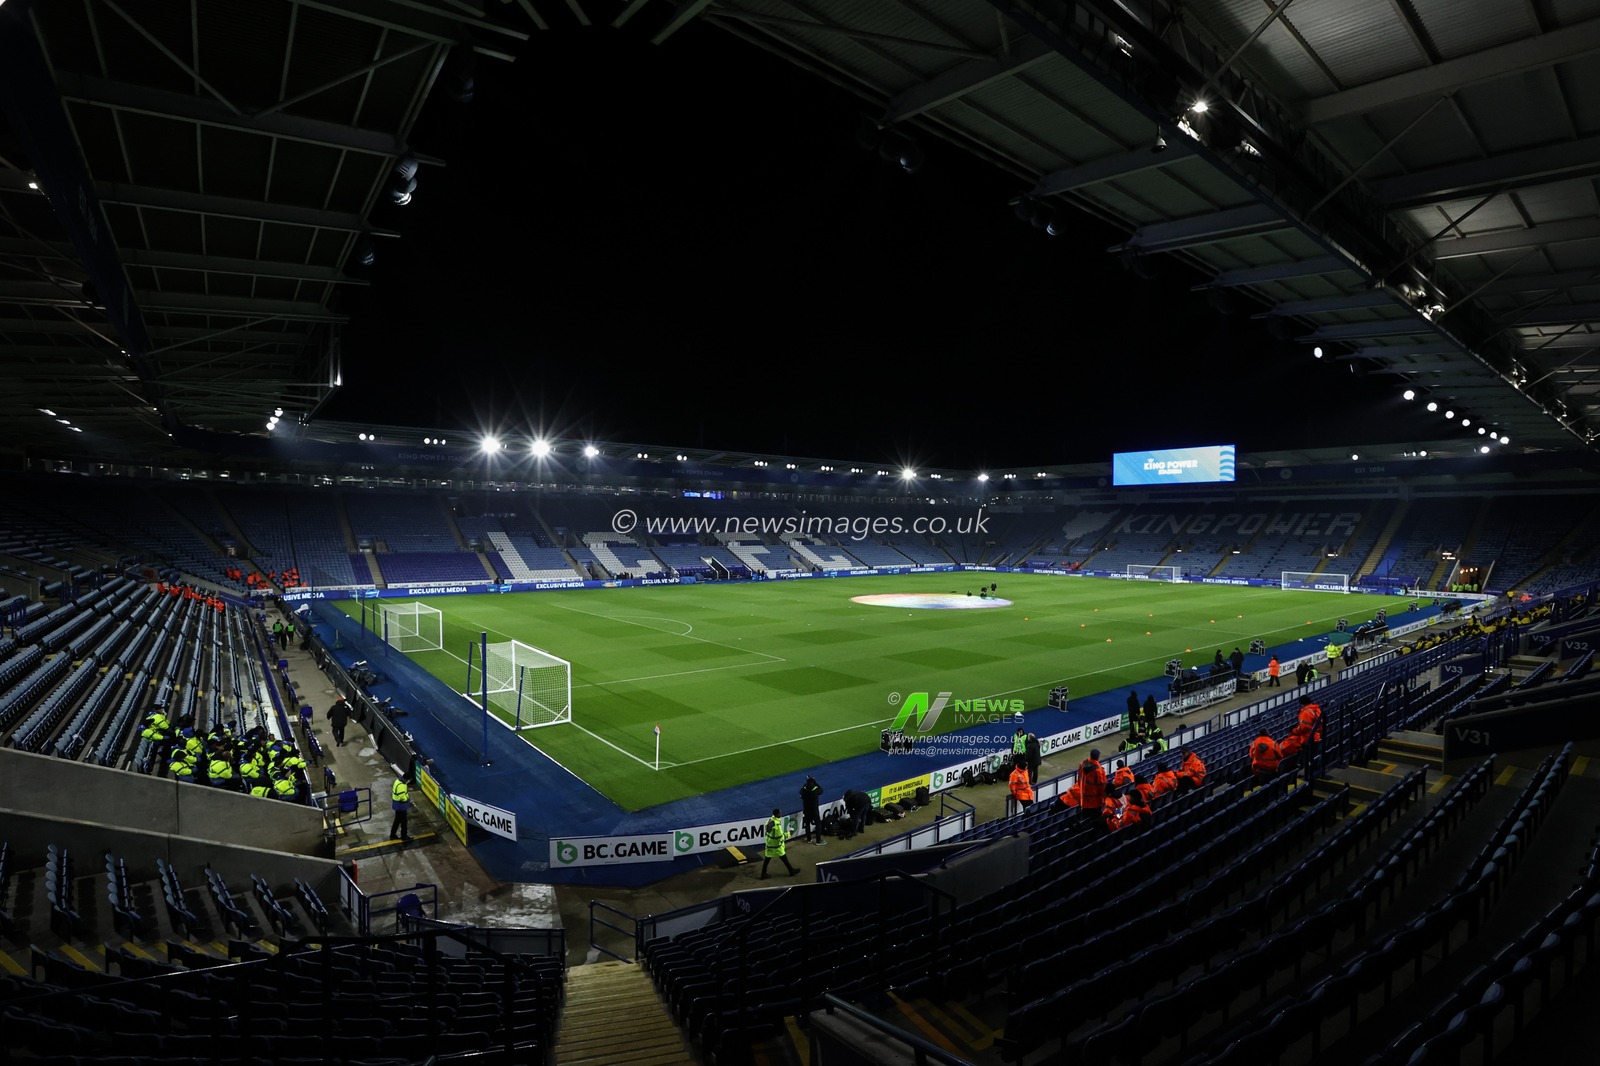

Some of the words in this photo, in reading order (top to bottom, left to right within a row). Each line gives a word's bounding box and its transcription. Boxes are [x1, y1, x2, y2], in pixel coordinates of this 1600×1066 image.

[1144, 461, 1166, 470] KING
[1167, 460, 1198, 469] POWER
[409, 587, 446, 595] EXCLUSIVE
[446, 586, 467, 594] MEDIA
[1531, 634, 1550, 643] V33
[1565, 640, 1589, 650] V32
[1444, 664, 1463, 674] V33
[1050, 731, 1081, 749] BC.GAME
[1092, 718, 1120, 736] BC.GAME
[1454, 727, 1490, 746] V31
[466, 805, 513, 834] BC.GAME
[699, 824, 766, 847] BC.GAM
[583, 840, 668, 860] BC.GAME
[736, 895, 751, 913] V30
